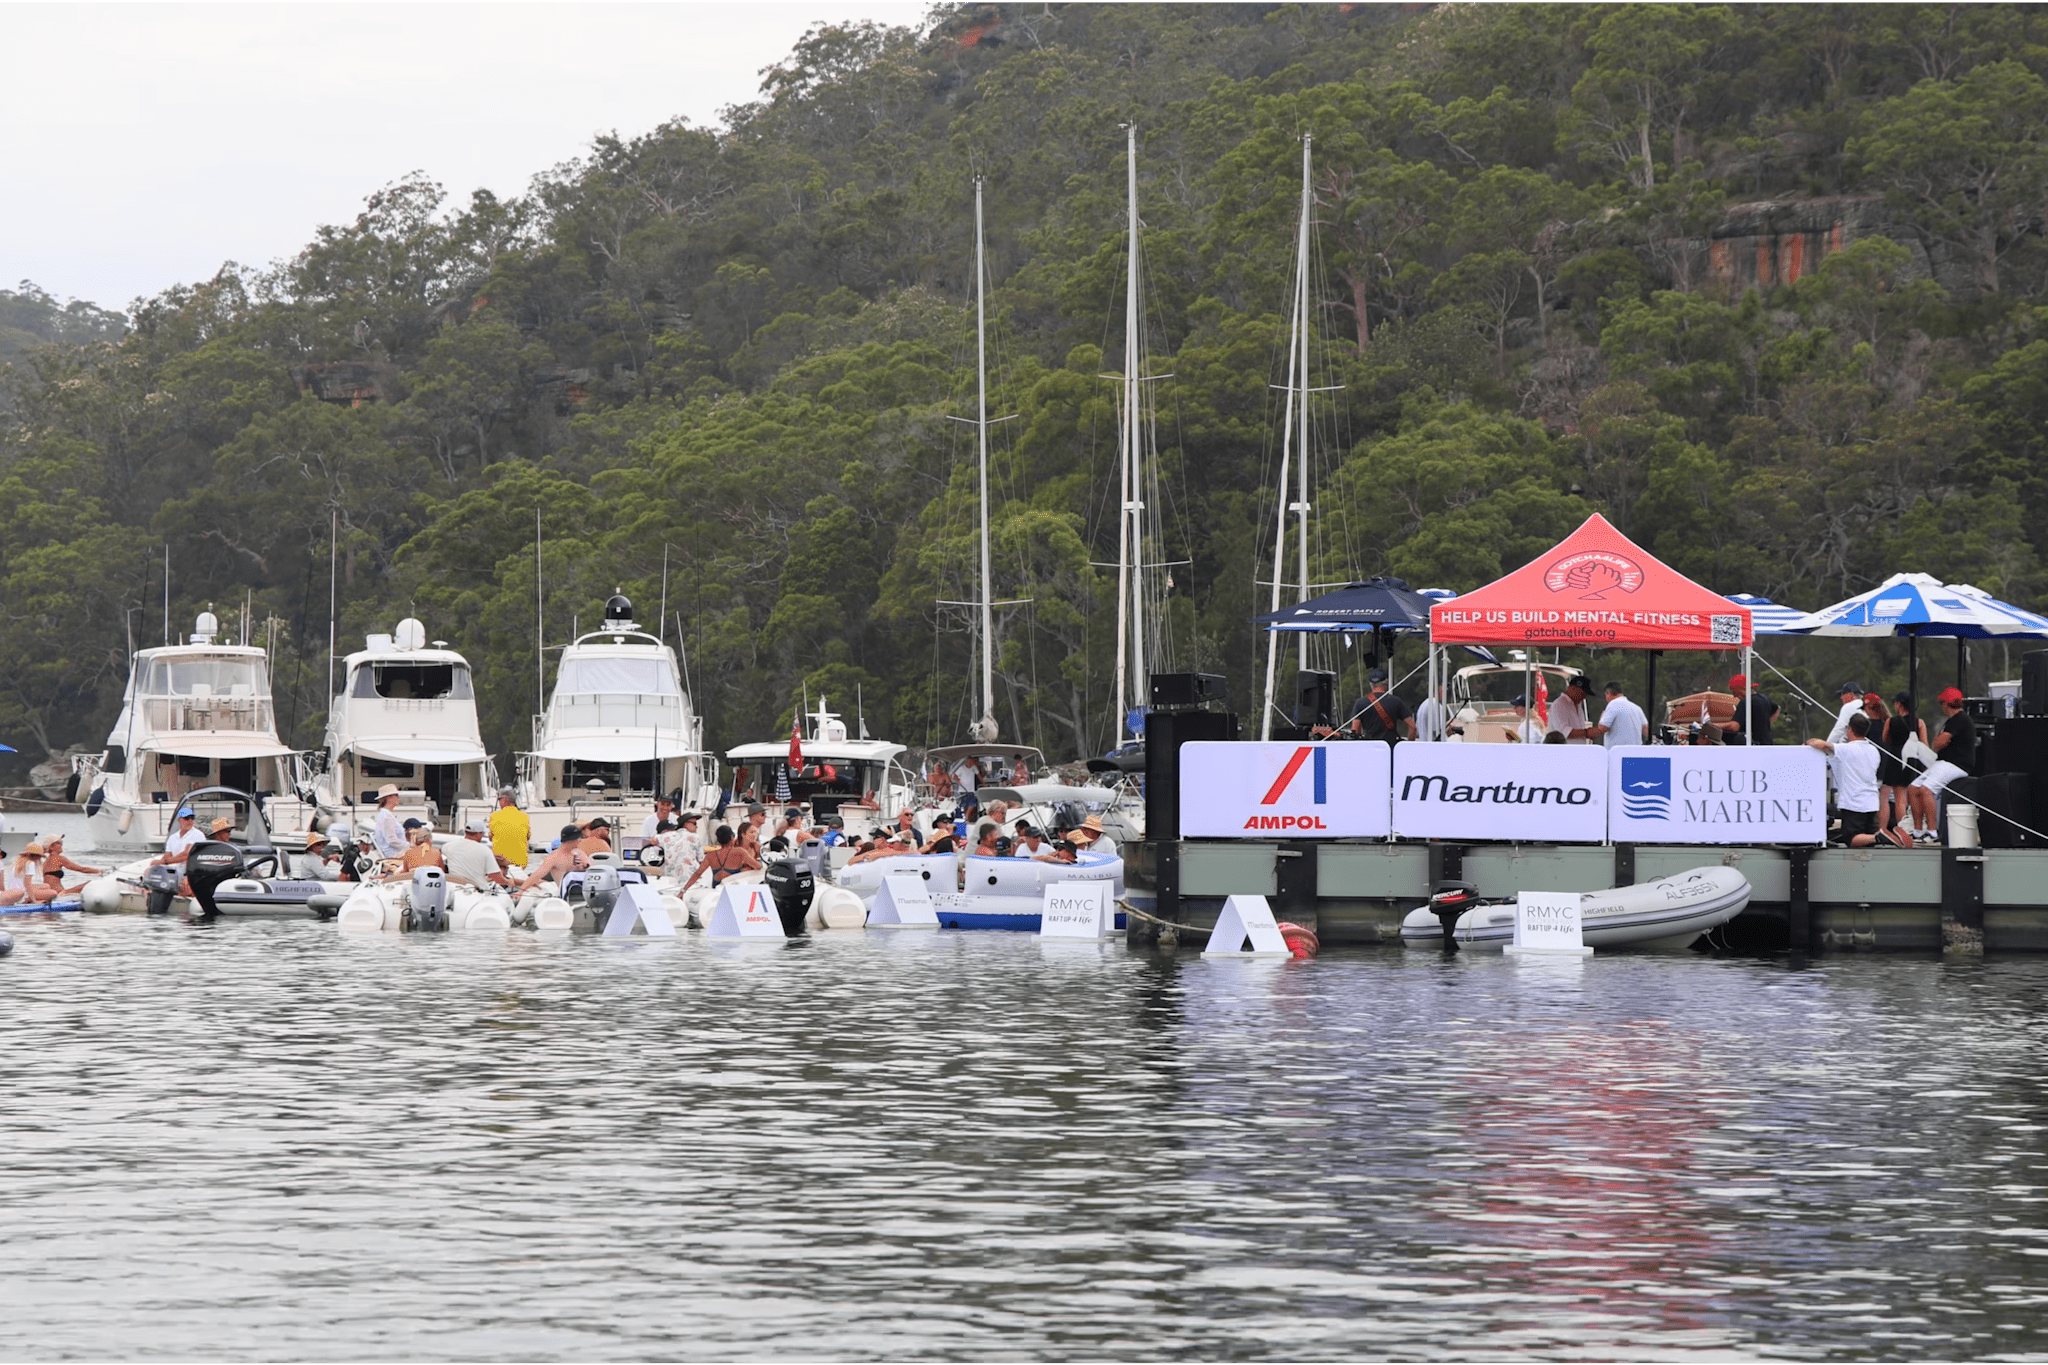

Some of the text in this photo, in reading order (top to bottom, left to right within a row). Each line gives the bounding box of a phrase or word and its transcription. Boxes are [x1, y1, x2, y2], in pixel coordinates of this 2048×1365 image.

[1558, 554, 1631, 570] GOTCHA4LIFE
[1441, 611, 1700, 625] HELP US BUILD MENTAL FITNESS
[1524, 627, 1616, 640] gotcha4life.org
[1683, 769, 1768, 794] CLUB
[1401, 775, 1591, 805] Maritimo
[1683, 799, 1814, 823] MARINE
[1243, 816, 1327, 830] AMPOL
[766, 872, 788, 883] MERCURY
[800, 879, 811, 888] 30
[1432, 889, 1464, 901] MERCURY
[1050, 898, 1094, 911] RMYC
[1584, 905, 1624, 916] HIGHFIELD
[1527, 906, 1574, 919] RMYC
[1079, 916, 1093, 925] life
[1560, 925, 1575, 934] life
